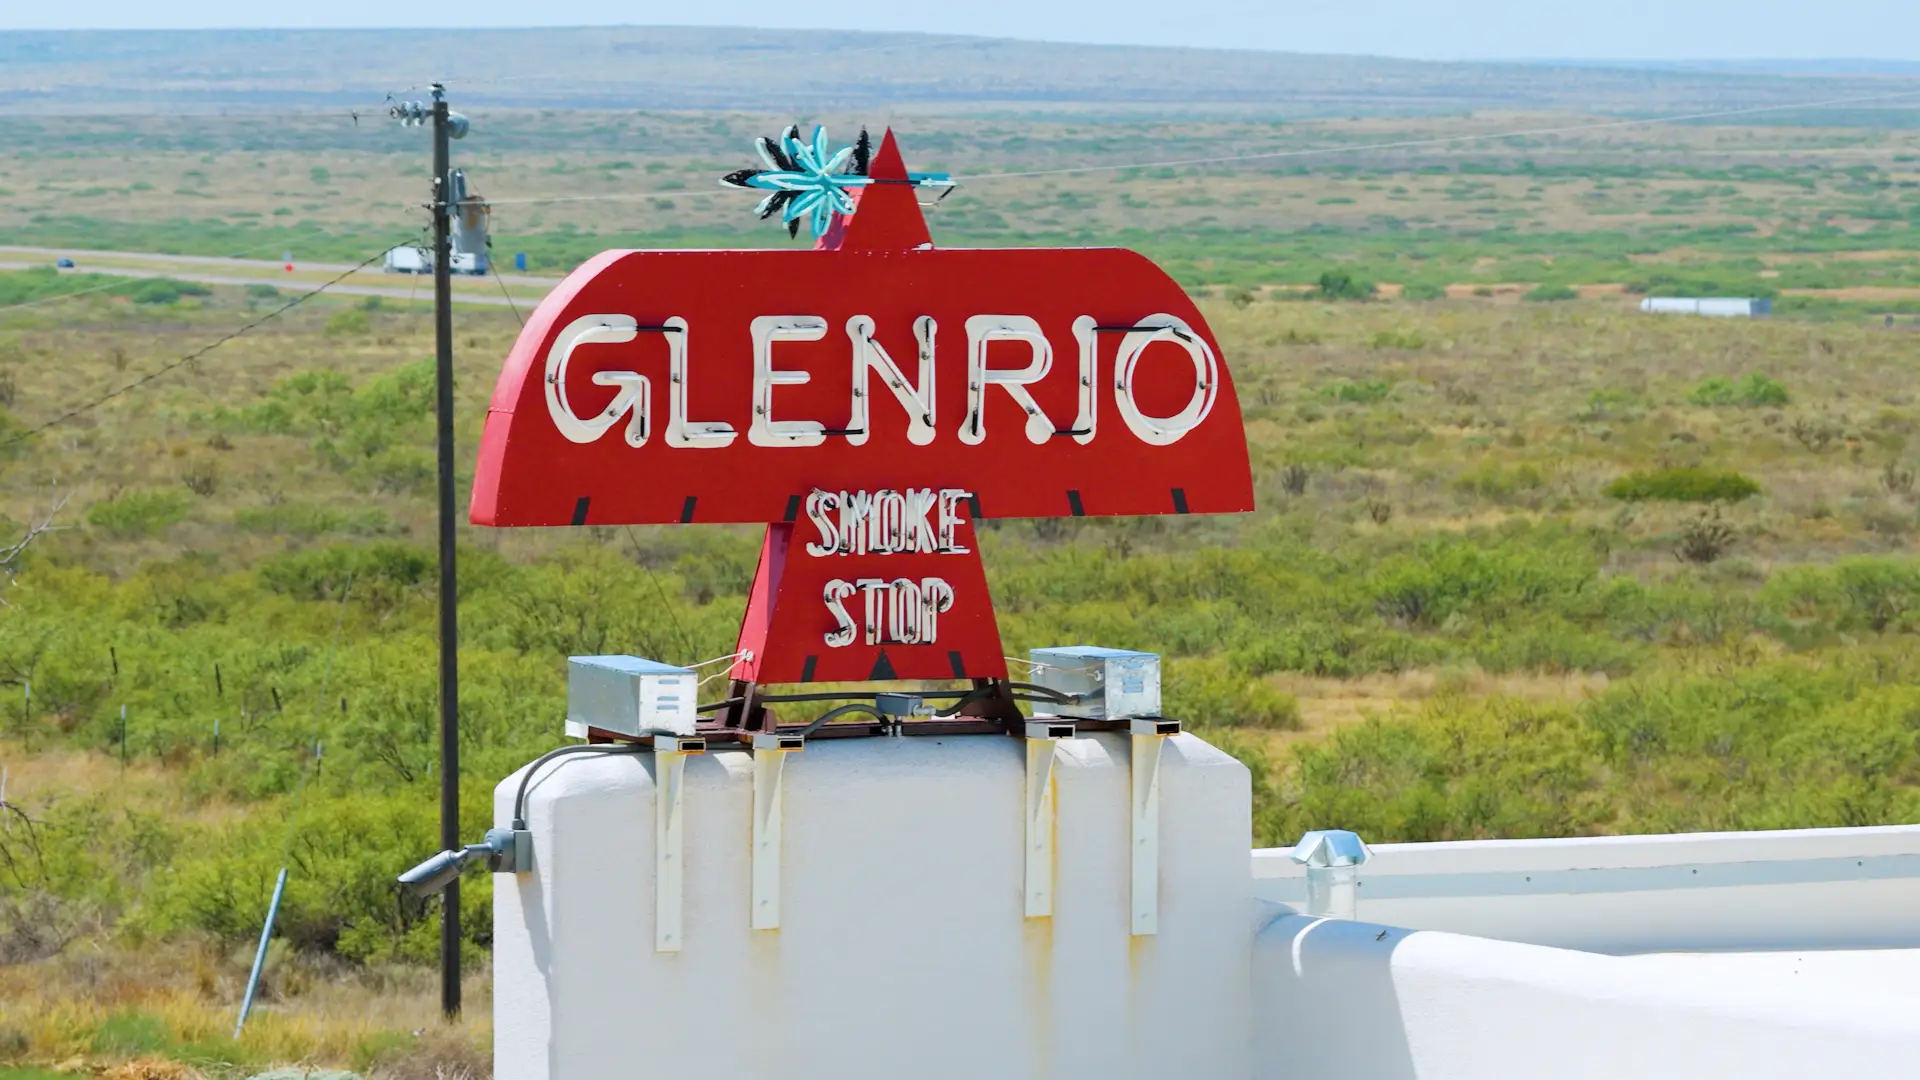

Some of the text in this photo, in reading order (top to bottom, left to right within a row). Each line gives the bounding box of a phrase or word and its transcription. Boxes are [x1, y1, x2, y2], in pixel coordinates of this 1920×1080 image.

[545, 313, 1218, 449] GLENRIO
[806, 488, 973, 557] SMOKE
[824, 577, 954, 648] STOP
